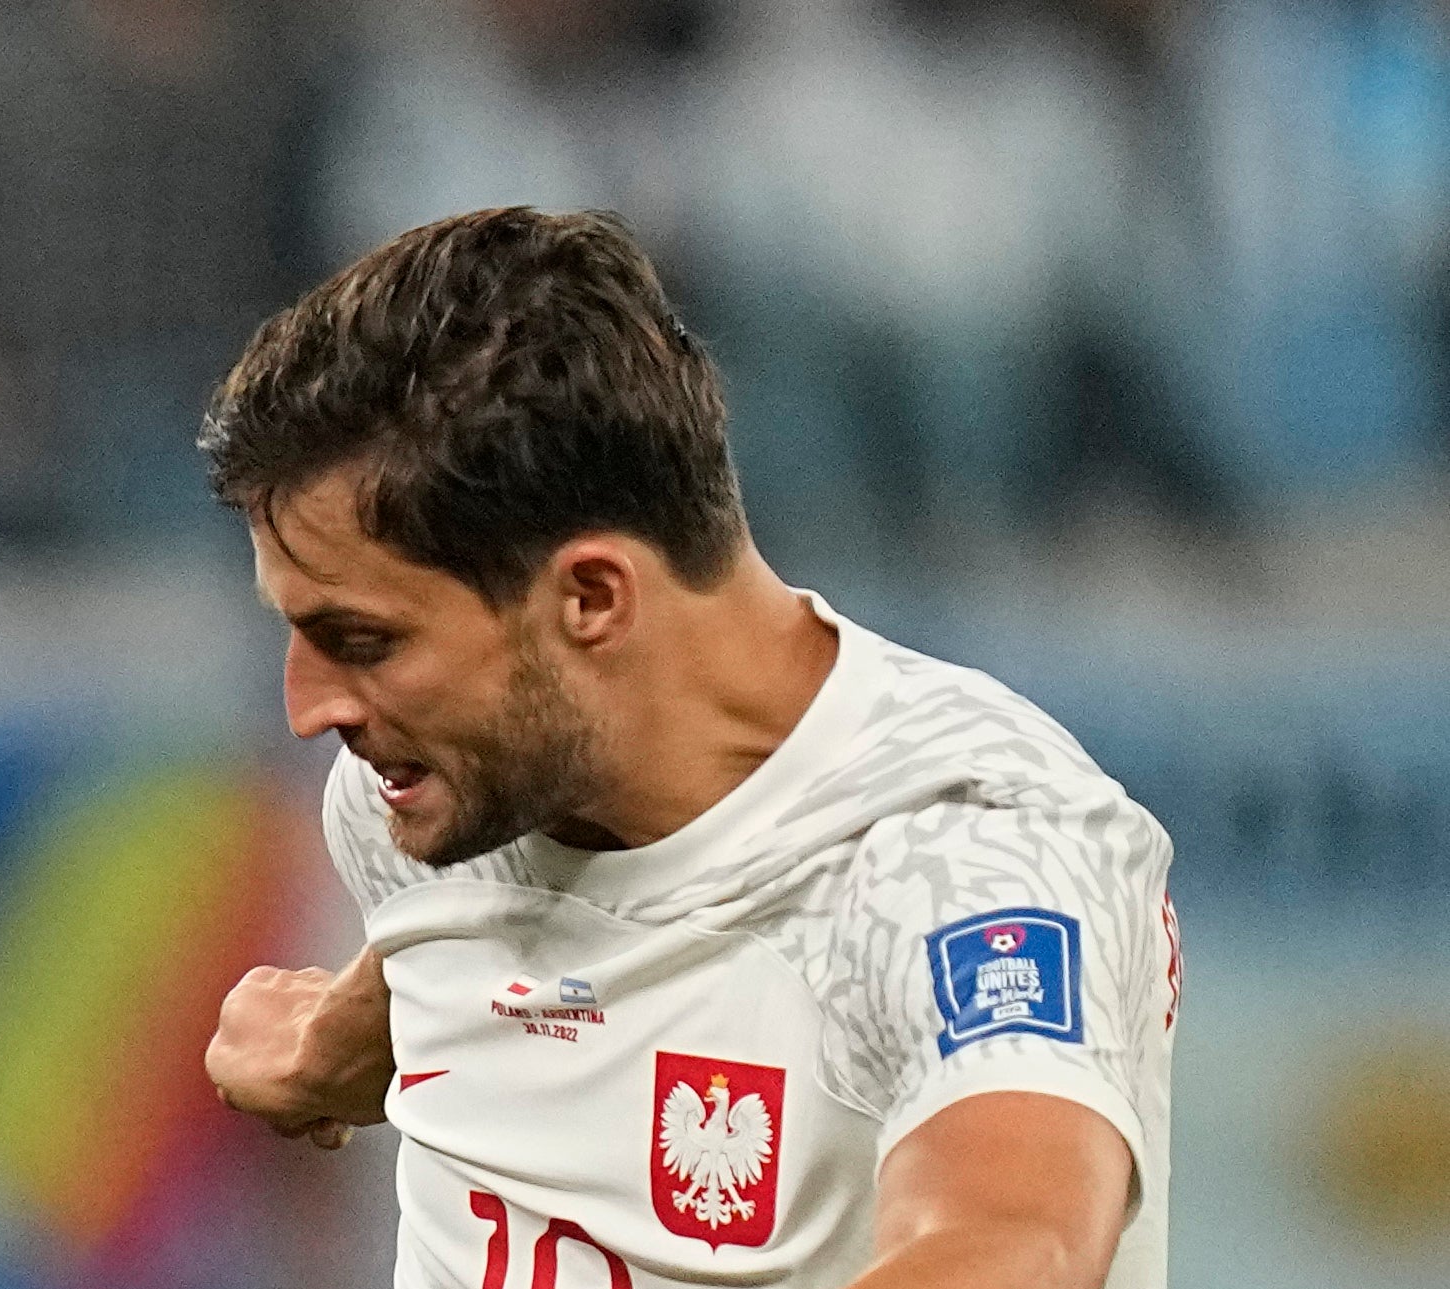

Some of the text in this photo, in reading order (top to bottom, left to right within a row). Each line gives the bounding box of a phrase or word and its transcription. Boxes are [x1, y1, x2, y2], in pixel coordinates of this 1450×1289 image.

[977, 970, 1041, 991] UNITES
[491, 1000, 532, 1019] POLAND
[541, 1008, 605, 1025] ARGENTINA
[522, 1022, 578, 1042] 30.11.2022
